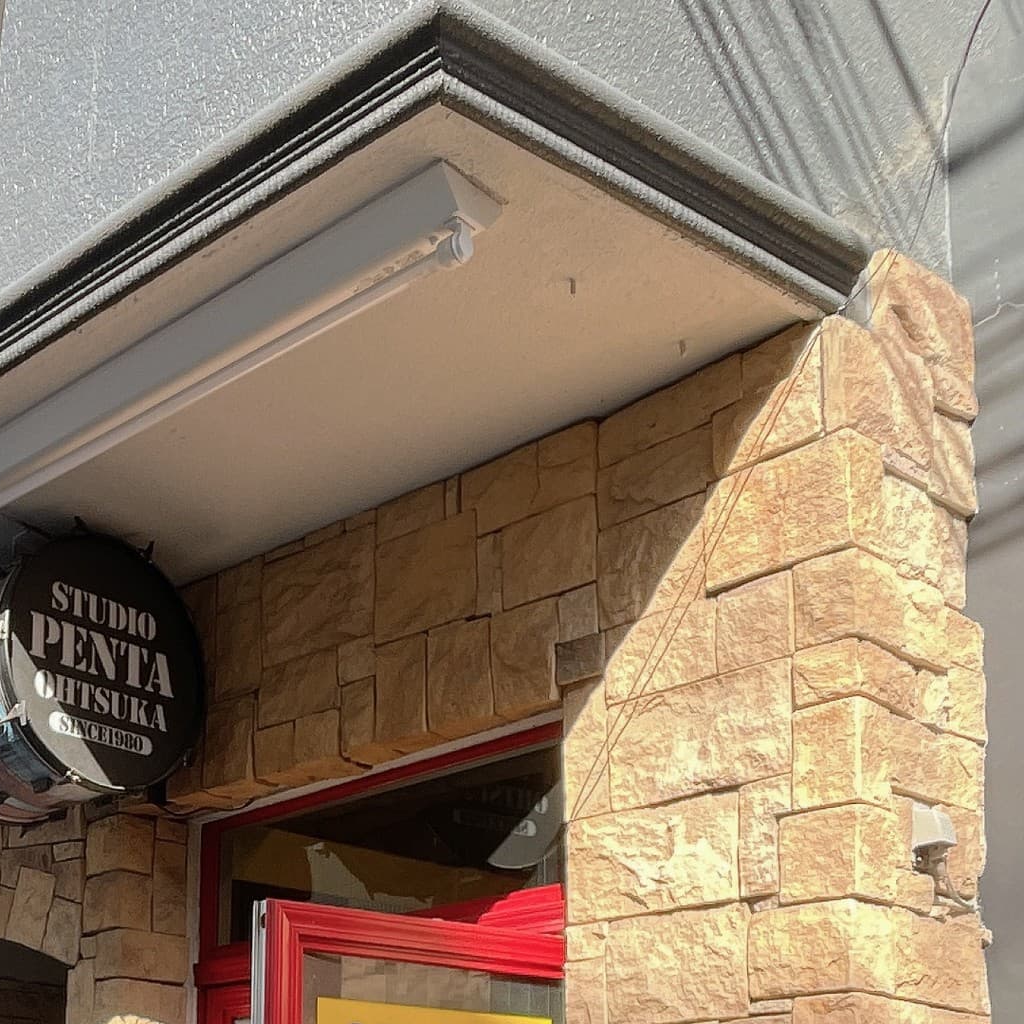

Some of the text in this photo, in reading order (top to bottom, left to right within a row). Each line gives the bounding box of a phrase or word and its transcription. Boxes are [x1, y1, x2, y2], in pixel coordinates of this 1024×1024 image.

[51, 581, 157, 641] STUDIO
[29, 610, 174, 698] PENTA
[34, 669, 168, 732] OHTSUKA
